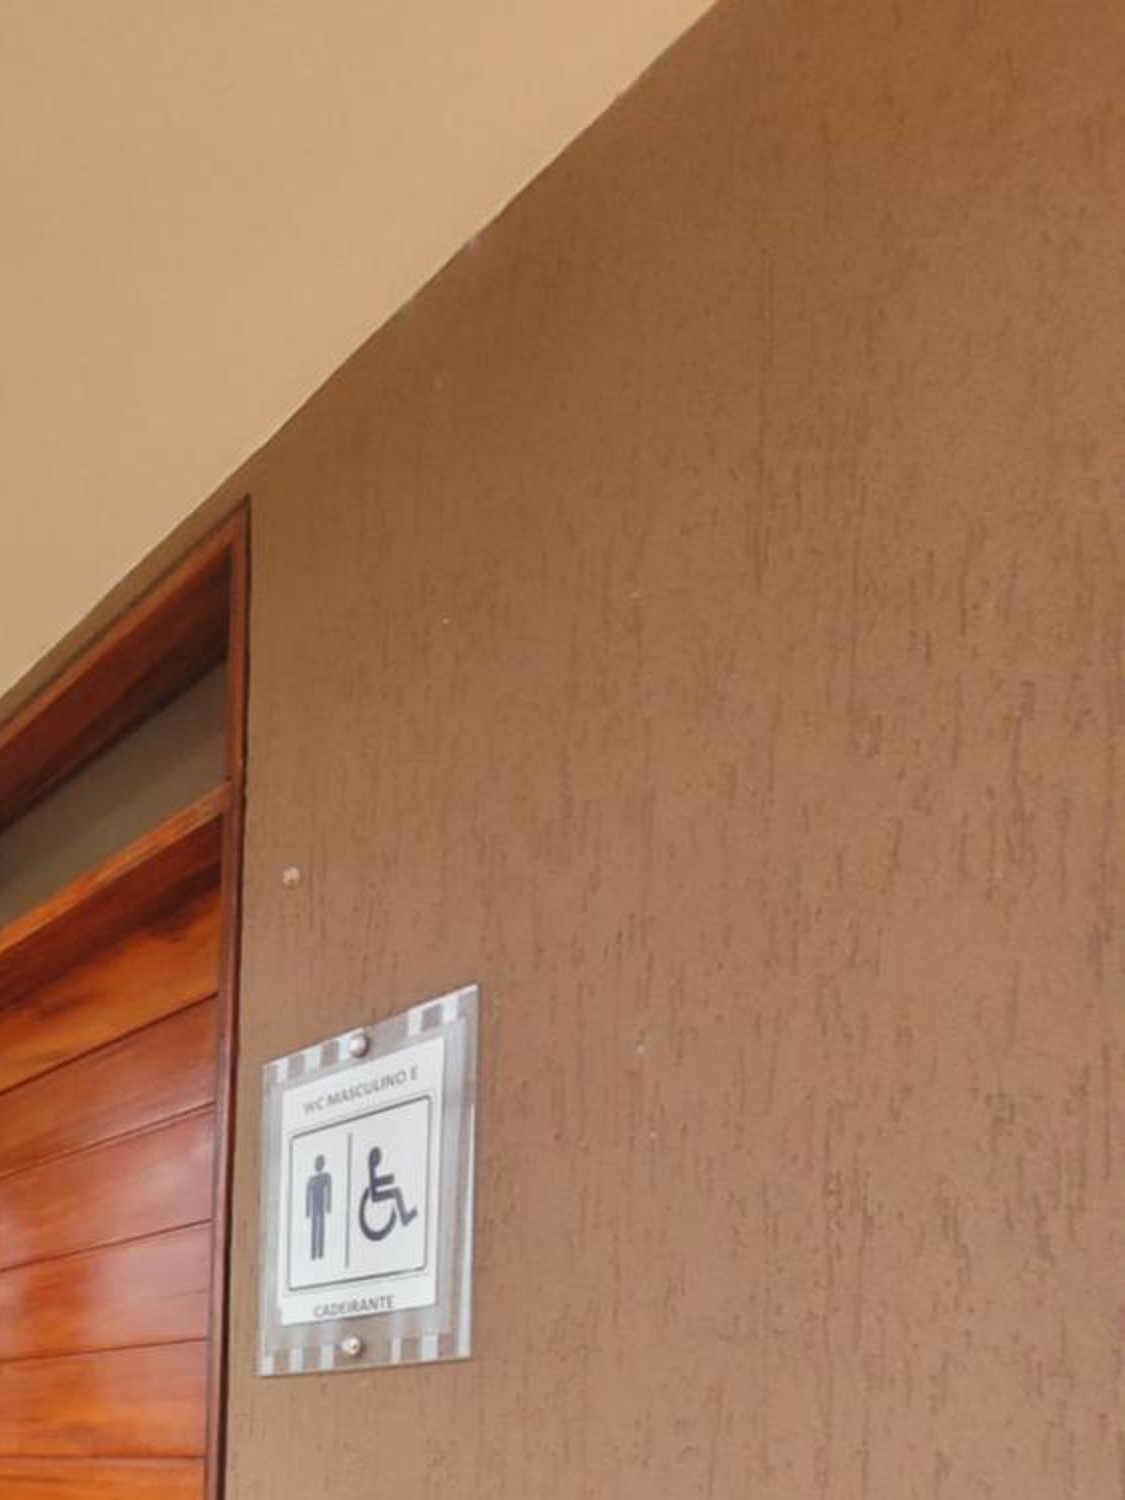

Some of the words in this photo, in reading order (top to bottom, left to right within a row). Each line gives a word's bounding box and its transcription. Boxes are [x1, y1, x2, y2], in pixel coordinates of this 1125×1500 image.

[302, 1096, 325, 1116] WC
[326, 1068, 407, 1106] MASCULINO
[410, 1064, 419, 1081] E
[313, 1295, 395, 1318] CADEIRANTE
